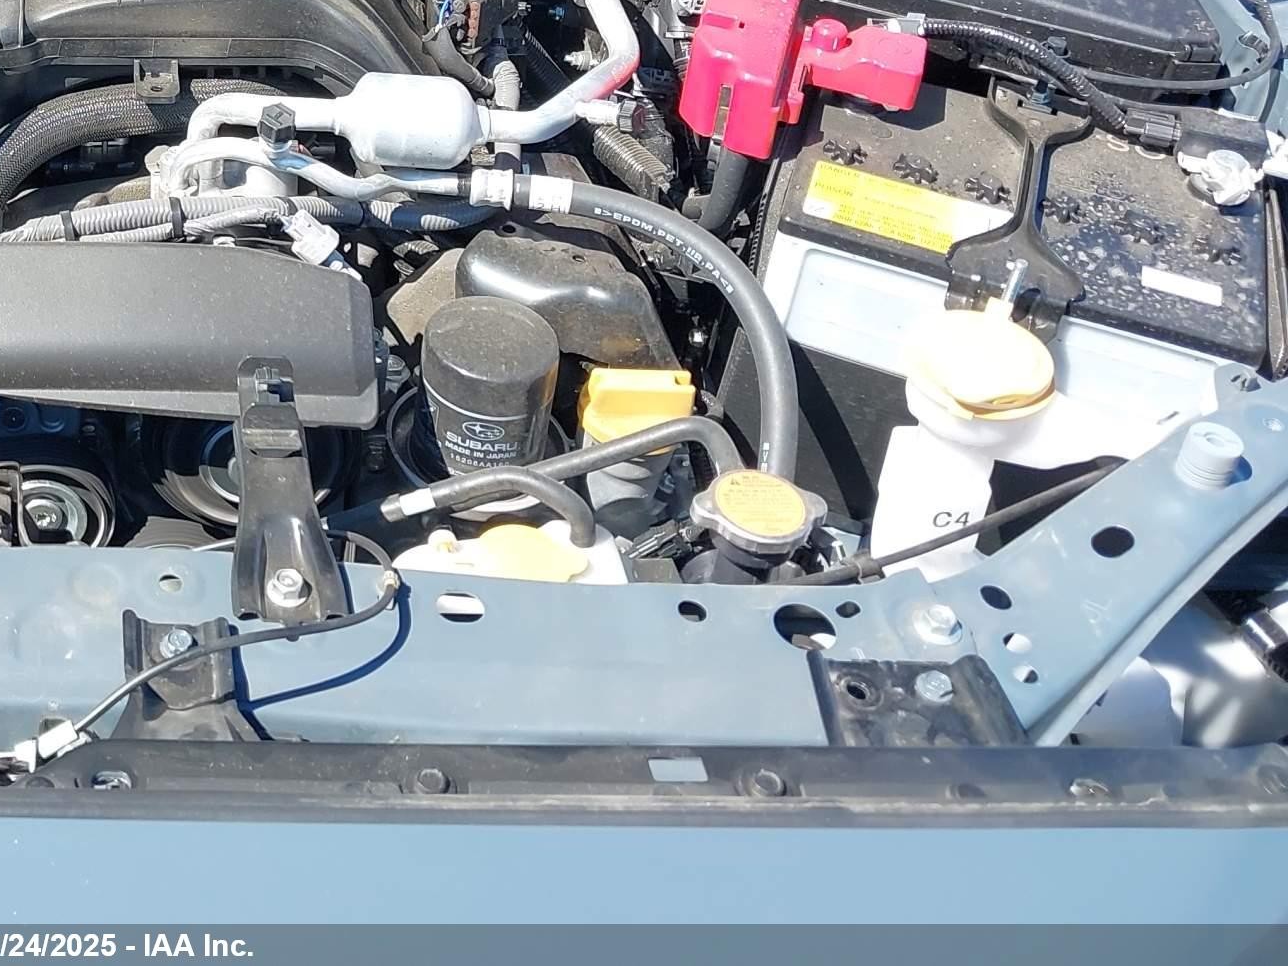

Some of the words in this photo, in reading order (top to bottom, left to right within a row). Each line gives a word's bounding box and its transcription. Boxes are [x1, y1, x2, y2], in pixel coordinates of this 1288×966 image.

[445, 440, 471, 456] MADE
[473, 450, 484, 459] IN
[486, 450, 517, 460] JAPAN
[446, 431, 518, 452] SUBARU
[933, 511, 970, 528] C4
